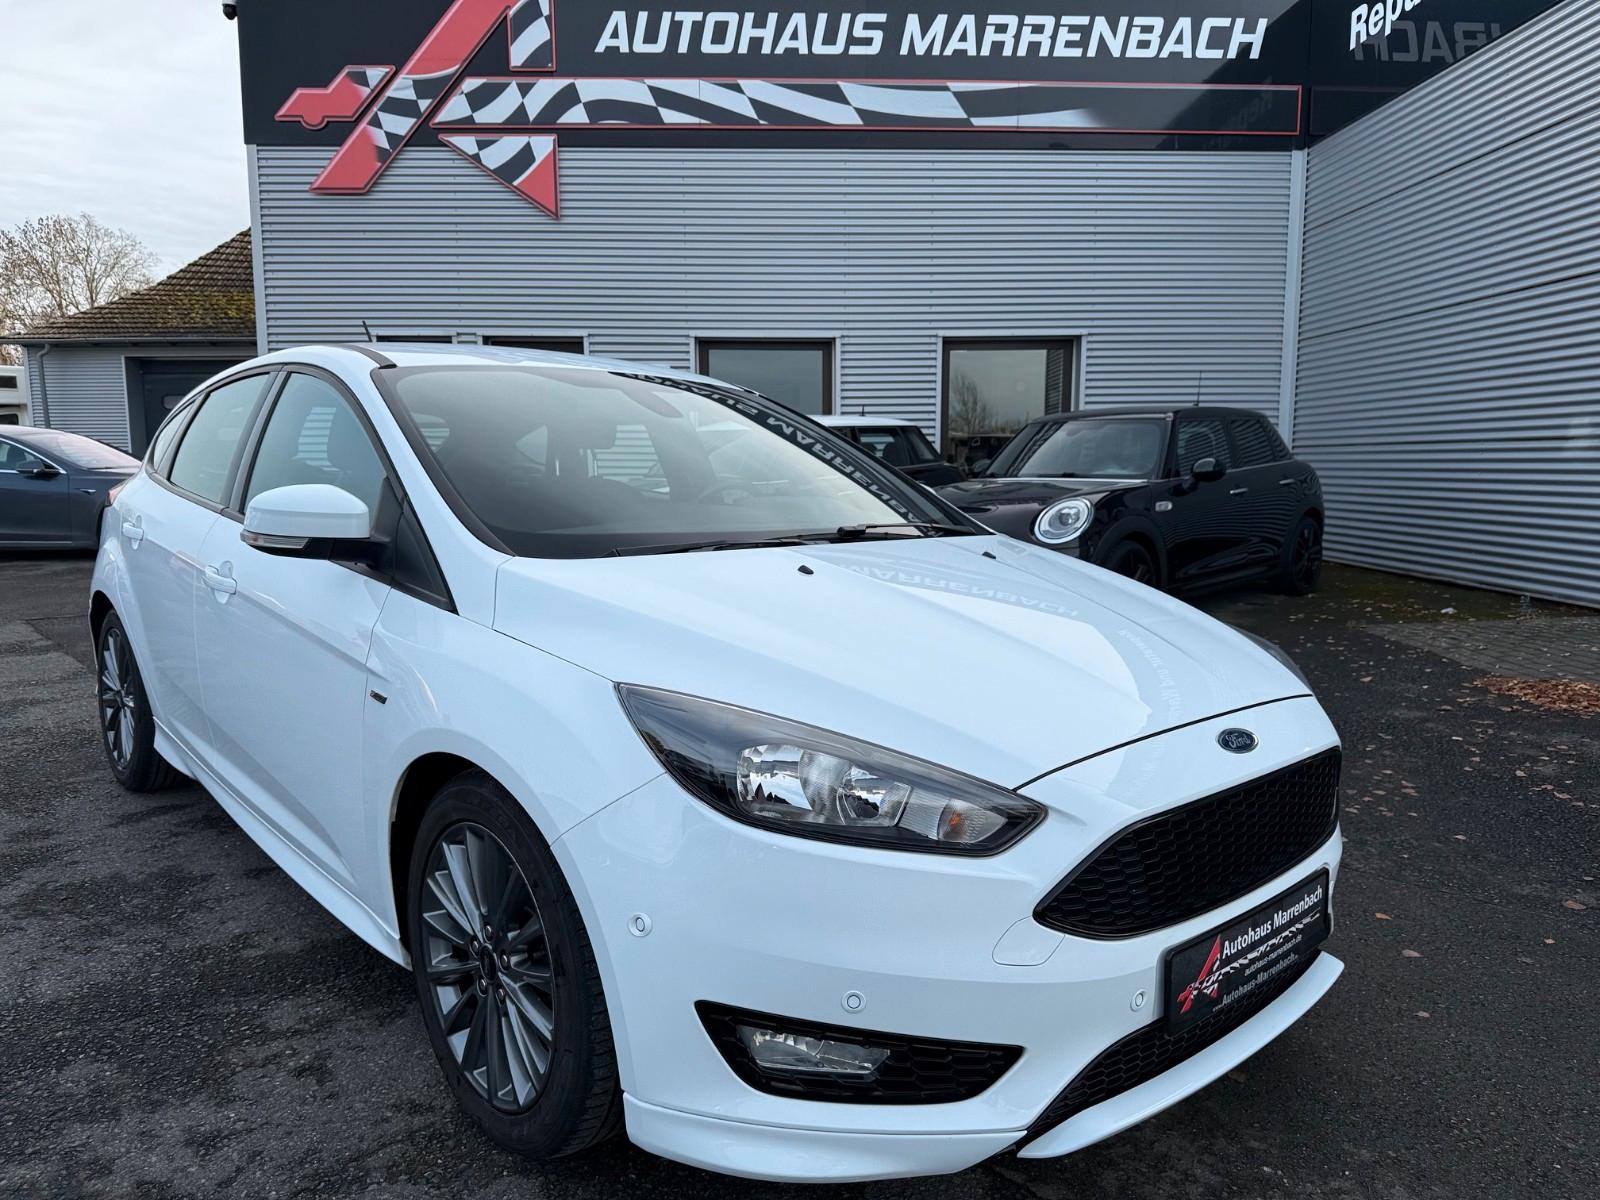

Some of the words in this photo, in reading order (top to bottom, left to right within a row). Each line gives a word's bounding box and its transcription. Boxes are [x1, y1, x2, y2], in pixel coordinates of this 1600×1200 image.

[595, 11, 887, 55] AUTOHAUS
[899, 14, 1267, 59] MARRENBACH
[1222, 921, 1272, 959] Autohaus
[1273, 885, 1323, 929] Marrenbach
[1245, 934, 1302, 976] autohaus-marrenbach.de
